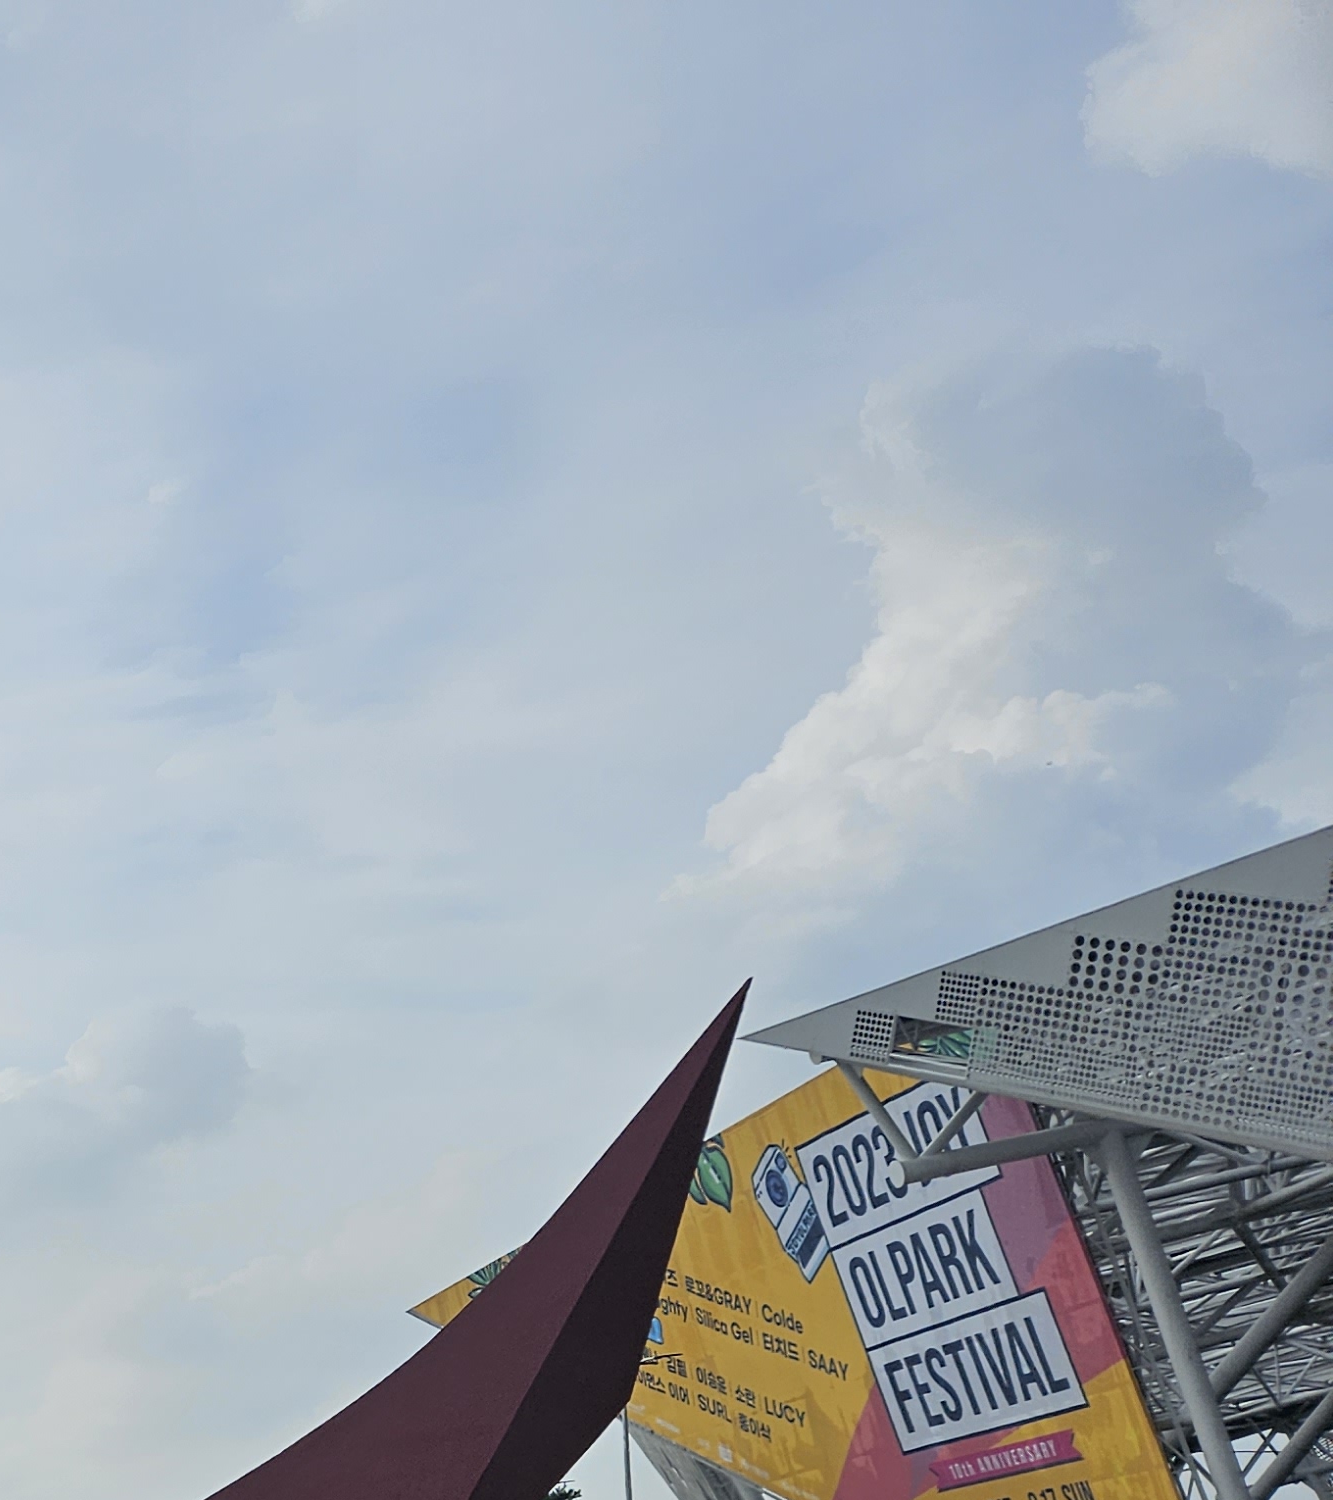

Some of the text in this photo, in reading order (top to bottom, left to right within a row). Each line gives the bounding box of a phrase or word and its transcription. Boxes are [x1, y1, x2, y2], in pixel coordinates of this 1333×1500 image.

[813, 1125, 908, 1229] 2023
[849, 1208, 1001, 1329] OLPARK
[695, 1307, 729, 1336] Silica
[730, 1321, 754, 1346] Gel
[762, 1331, 801, 1362] 터치드
[807, 1349, 849, 1382] SAAY
[761, 1303, 804, 1335] Colde
[668, 1382, 691, 1405] 이어
[697, 1394, 733, 1424] SURL
[884, 1316, 1071, 1435] FESTIVAL
[734, 1385, 757, 1409] 소란
[763, 1396, 806, 1428] LUCY
[948, 1438, 1059, 1481] 10th ANNIVERSARY
